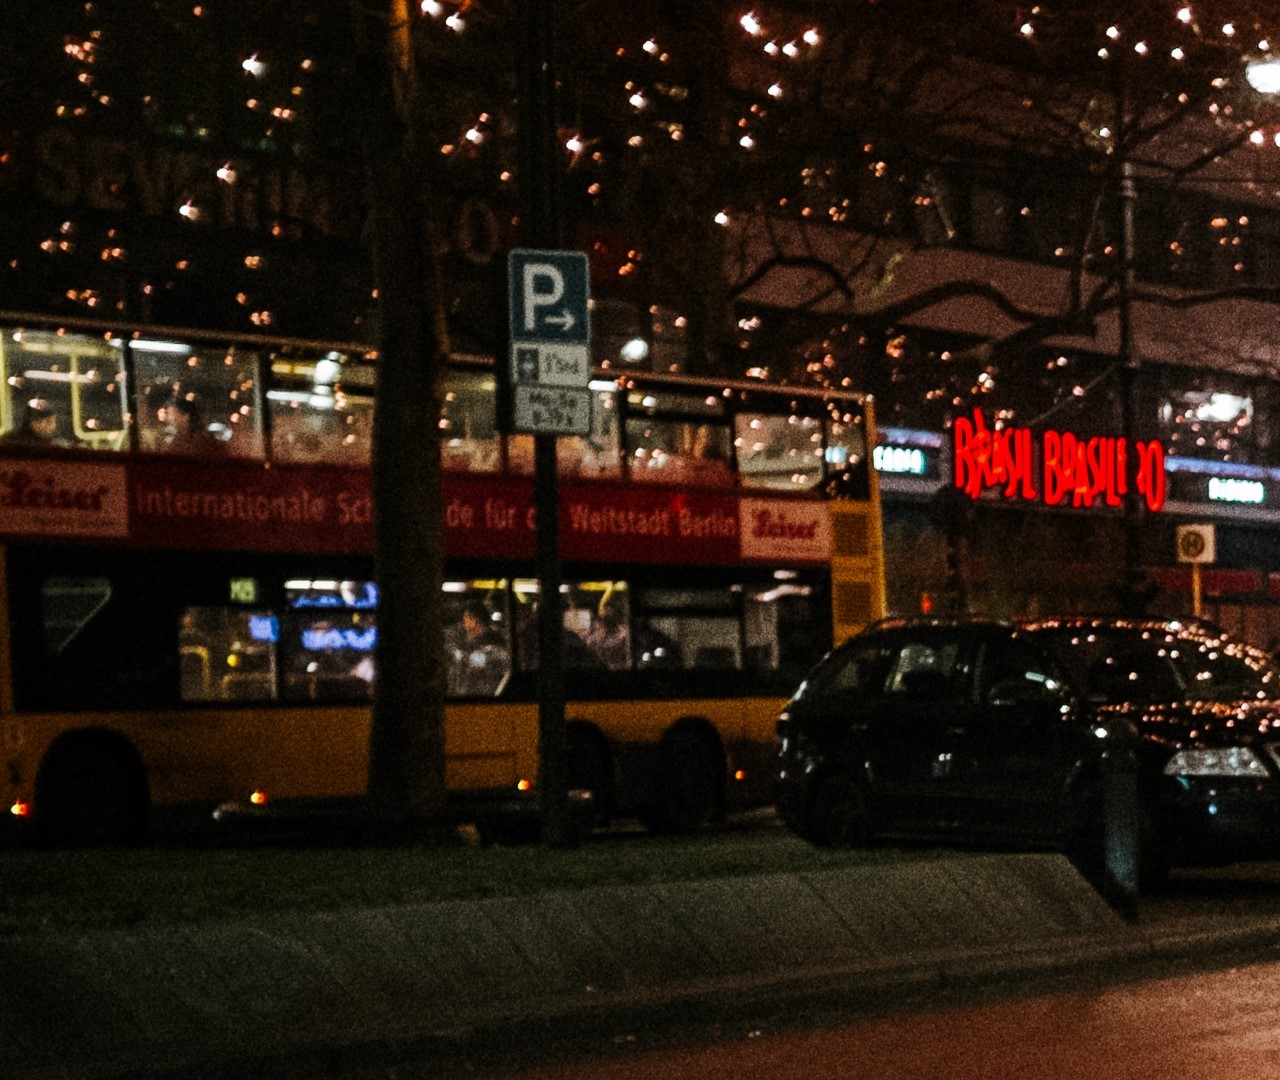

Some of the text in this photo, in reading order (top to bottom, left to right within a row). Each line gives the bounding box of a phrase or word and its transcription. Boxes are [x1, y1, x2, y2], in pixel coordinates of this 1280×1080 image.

[523, 263, 564, 331] P
[136, 484, 326, 523] Internationale
[484, 499, 516, 530] für
[570, 504, 670, 538] Weltstadt
[680, 507, 738, 538] Berlin
[752, 509, 820, 542] Leiser
